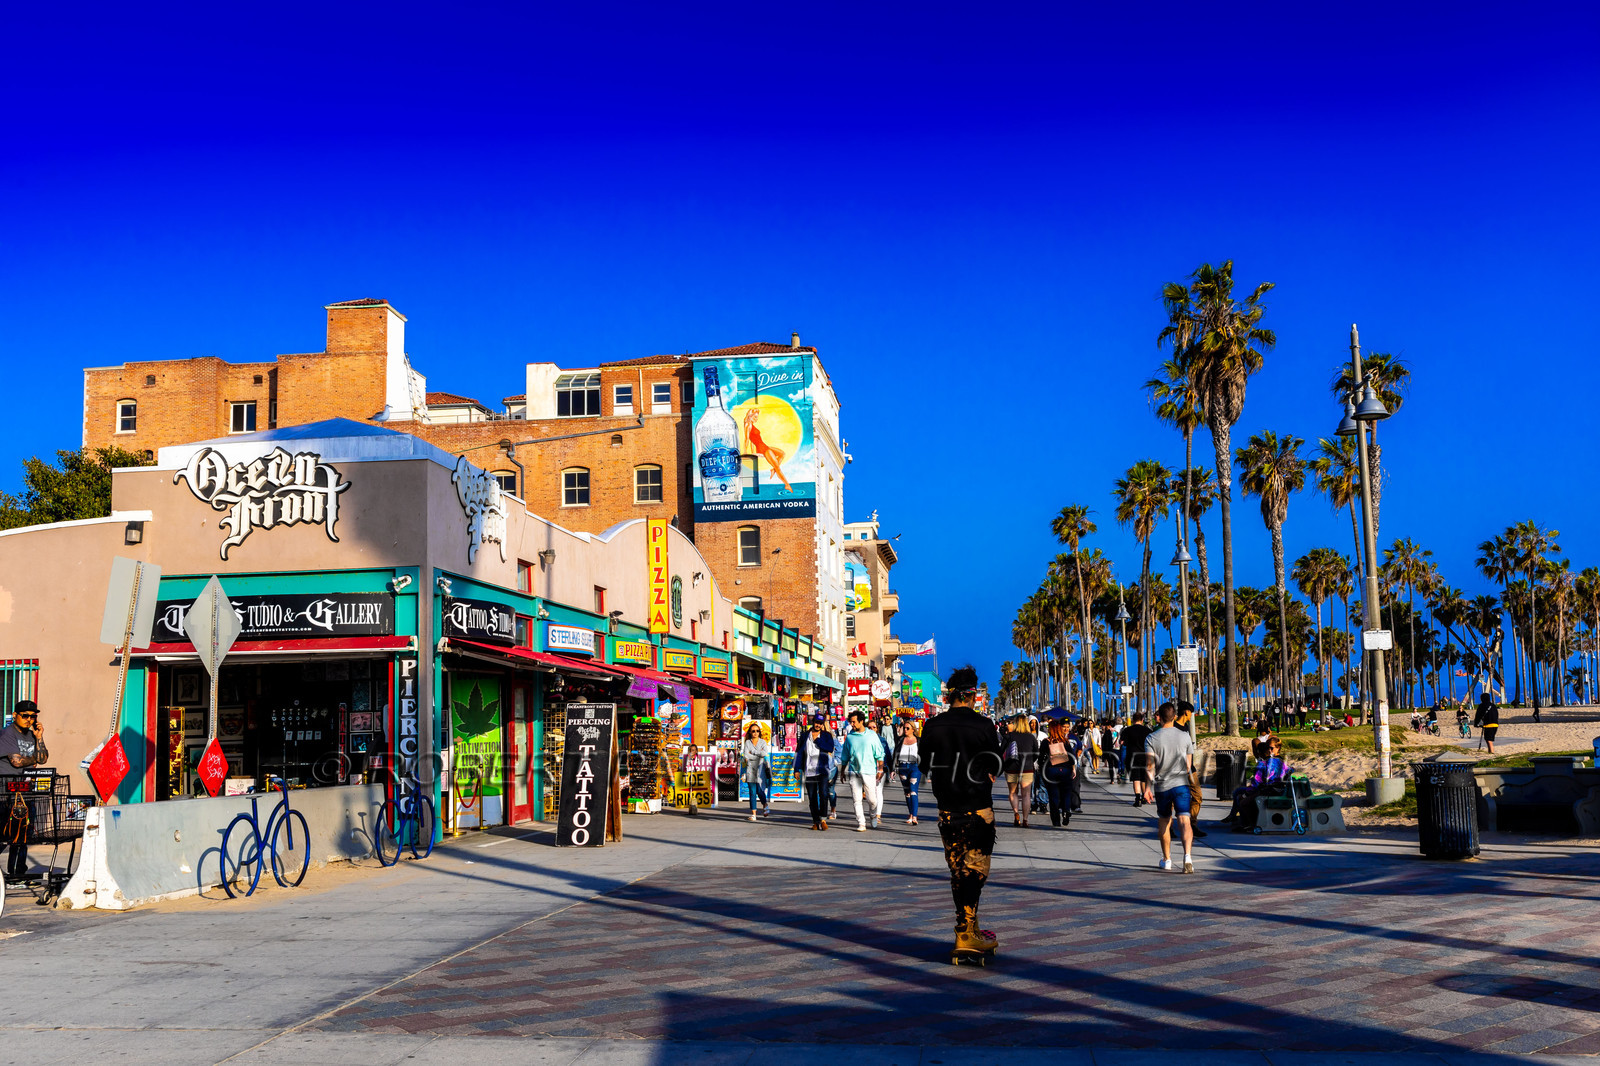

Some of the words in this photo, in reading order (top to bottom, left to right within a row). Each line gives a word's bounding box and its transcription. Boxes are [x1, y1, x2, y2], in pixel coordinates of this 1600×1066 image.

[758, 372, 788, 387] Dive
[791, 370, 804, 380] in
[173, 447, 322, 503] Ocean
[743, 502, 781, 510] AMERICAN
[783, 500, 810, 508] VODKA
[652, 526, 667, 626] PIZZA
[284, 608, 295, 622] &
[550, 629, 580, 646] STERLING
[625, 643, 644, 658] PIZZA
[896, 707, 915, 715] TATTOO
[568, 718, 611, 726] PIERCING
[400, 659, 418, 816] PIERCING
[454, 741, 501, 755] CULTIVATION
[462, 753, 494, 766] LICENSE
[682, 774, 704, 787] TOE
[571, 744, 596, 846] TATTOO
